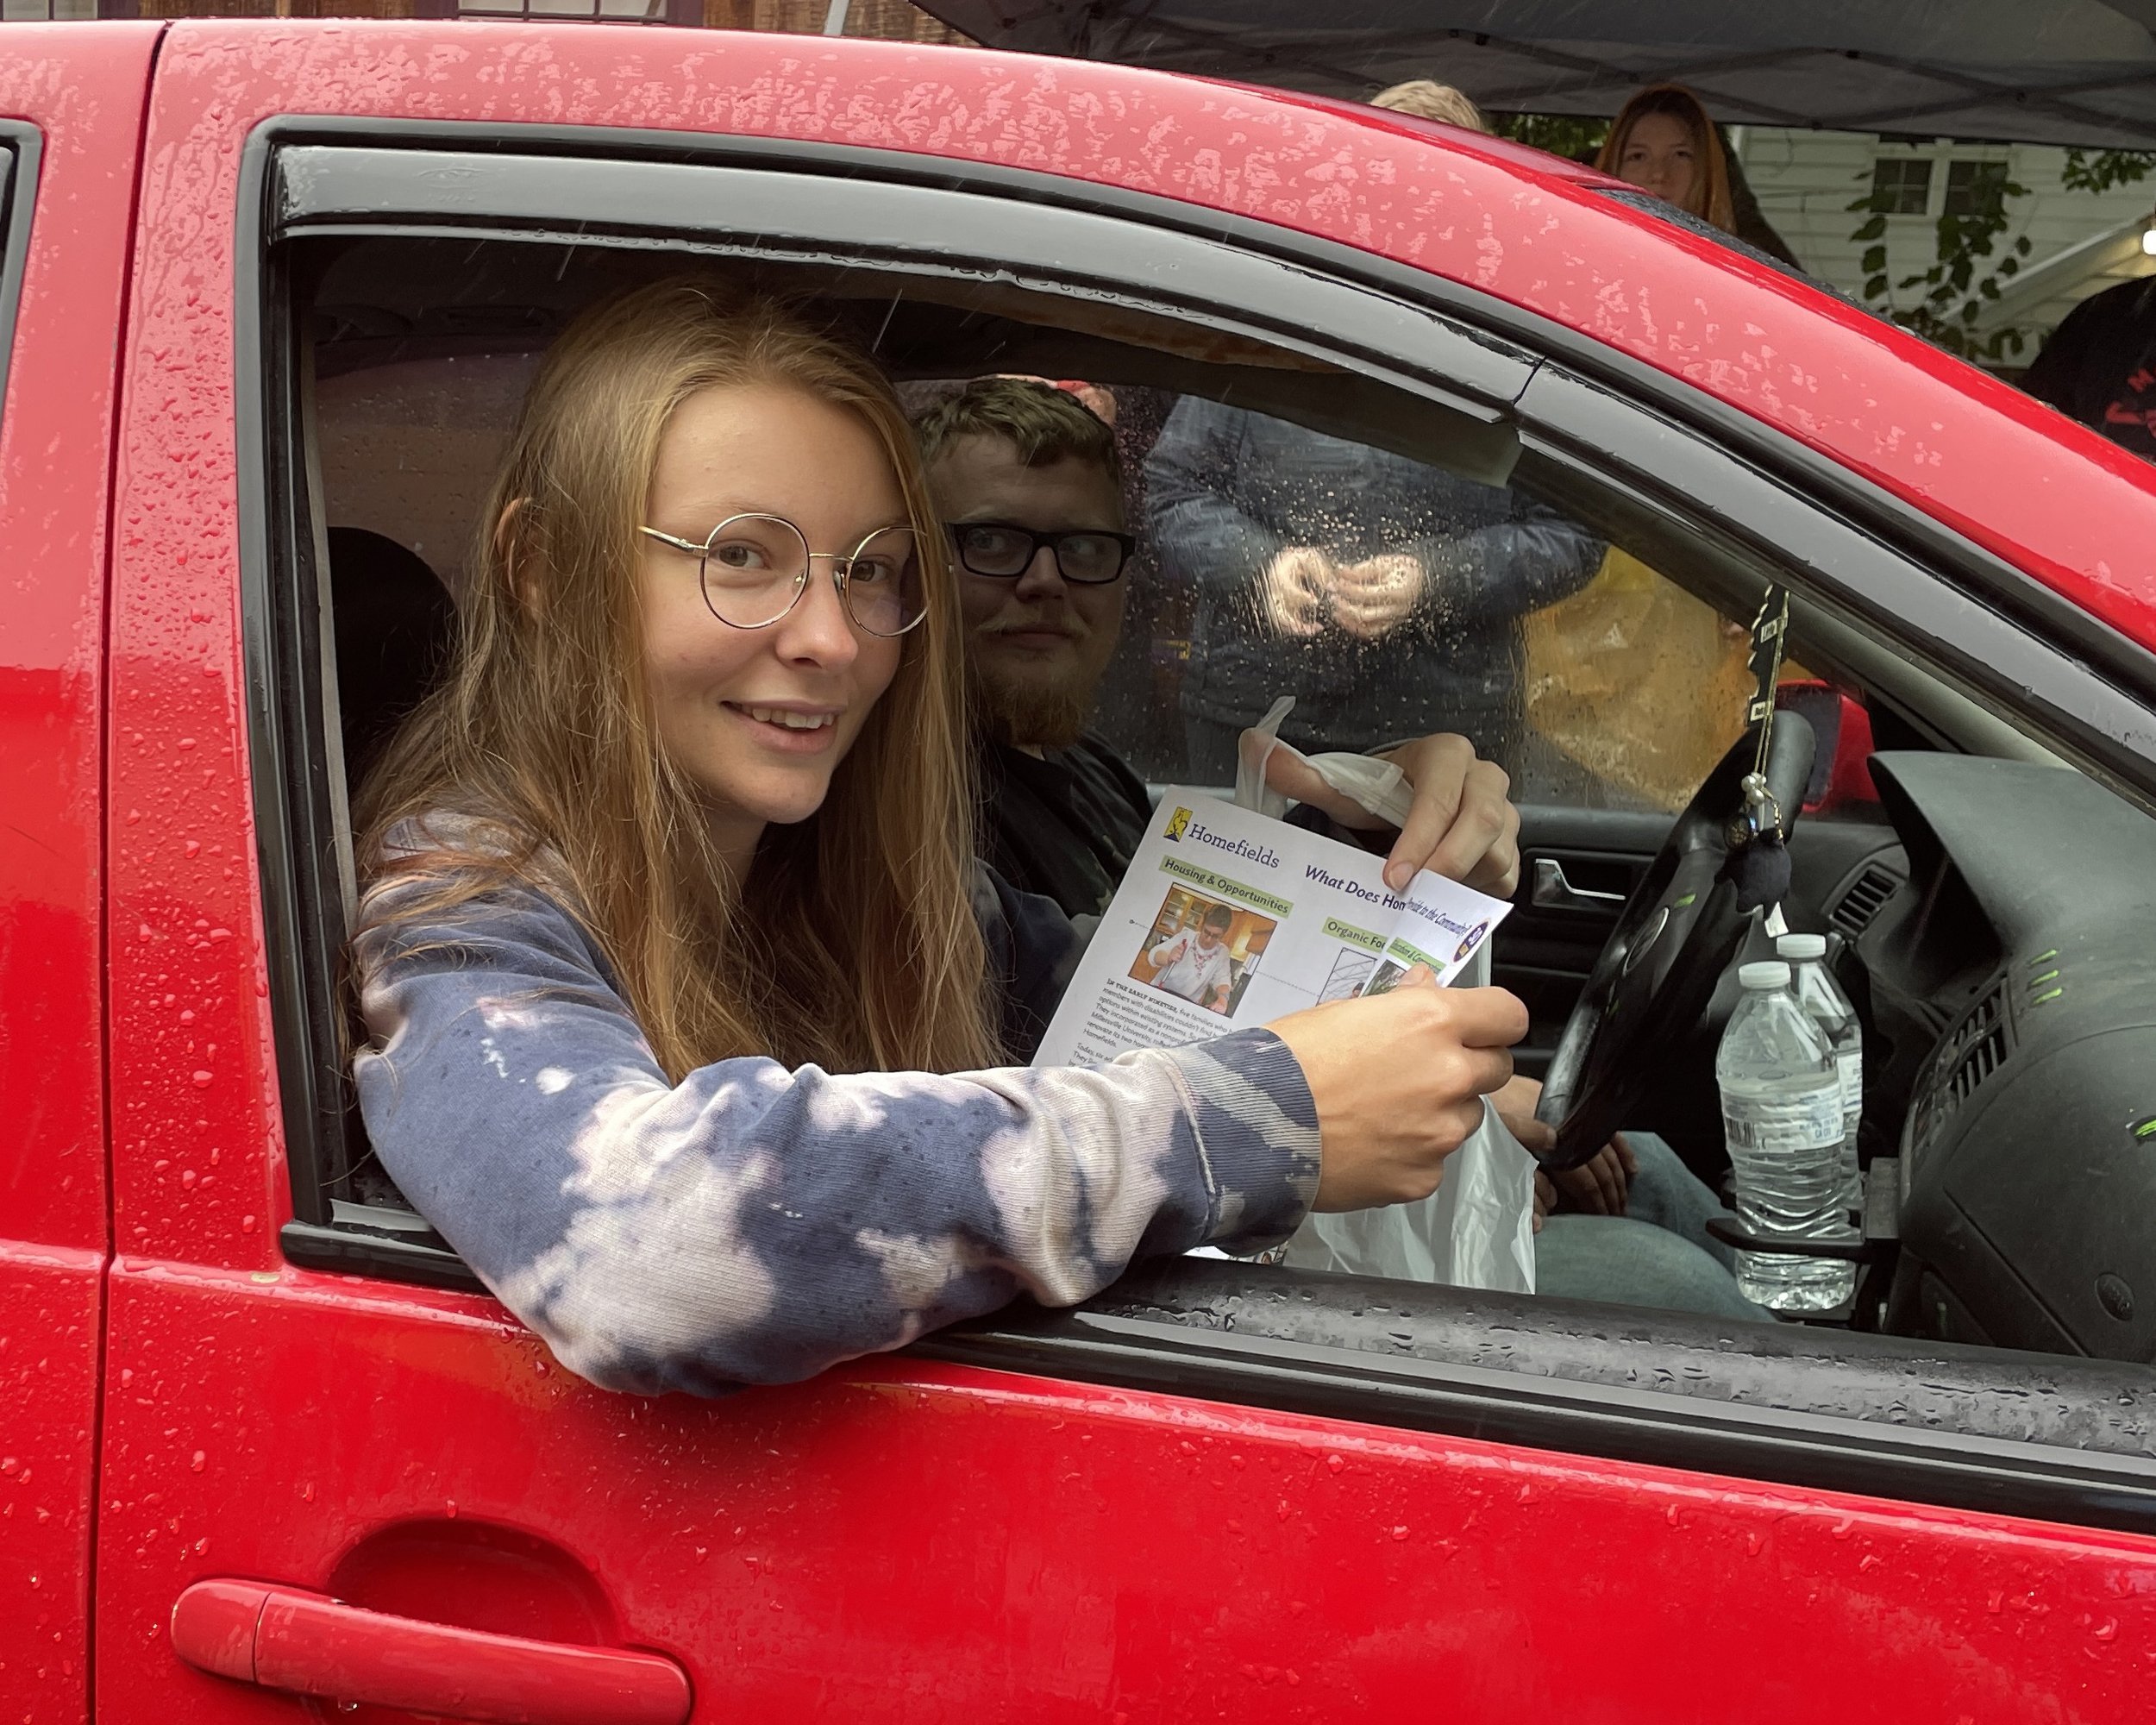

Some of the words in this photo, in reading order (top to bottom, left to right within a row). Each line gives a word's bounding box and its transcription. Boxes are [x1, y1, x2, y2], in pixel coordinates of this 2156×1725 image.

[1188, 824, 1280, 869] Homefields
[1164, 858, 1206, 884] Housing
[1206, 875, 1215, 885] &
[1217, 879, 1289, 913] Opportunities
[1305, 865, 1344, 890] What
[1344, 881, 1381, 904] Does
[1327, 921, 1369, 944] Organic
